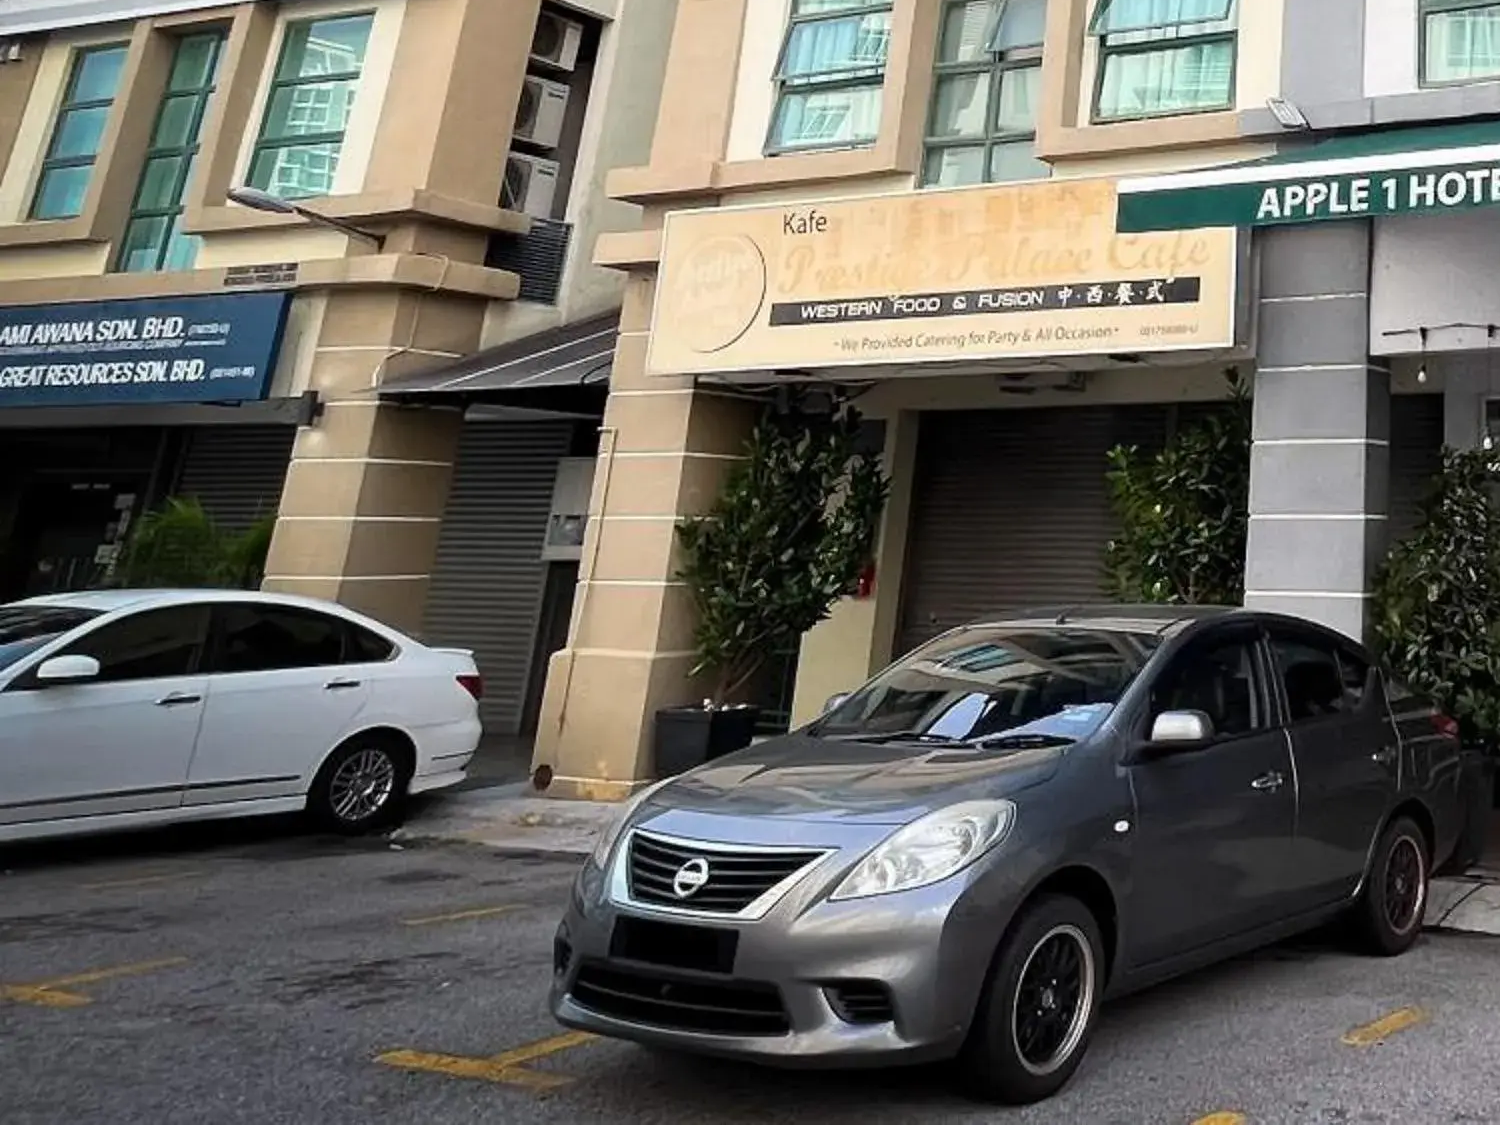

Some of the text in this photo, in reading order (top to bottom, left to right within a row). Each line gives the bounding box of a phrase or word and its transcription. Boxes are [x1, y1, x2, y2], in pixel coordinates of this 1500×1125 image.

[1256, 178, 1371, 220] APPLE
[1381, 174, 1398, 211] 1
[783, 210, 829, 237] Kafe
[800, 298, 883, 319] WESTERN
[892, 296, 941, 314] FOOD
[951, 295, 968, 311] &
[977, 290, 1045, 308] FUSION
[30, 321, 94, 345] AWANA
[840, 324, 1113, 352] We Provided Catering for Party & All Occasion
[44, 361, 135, 386] RESOURCES
